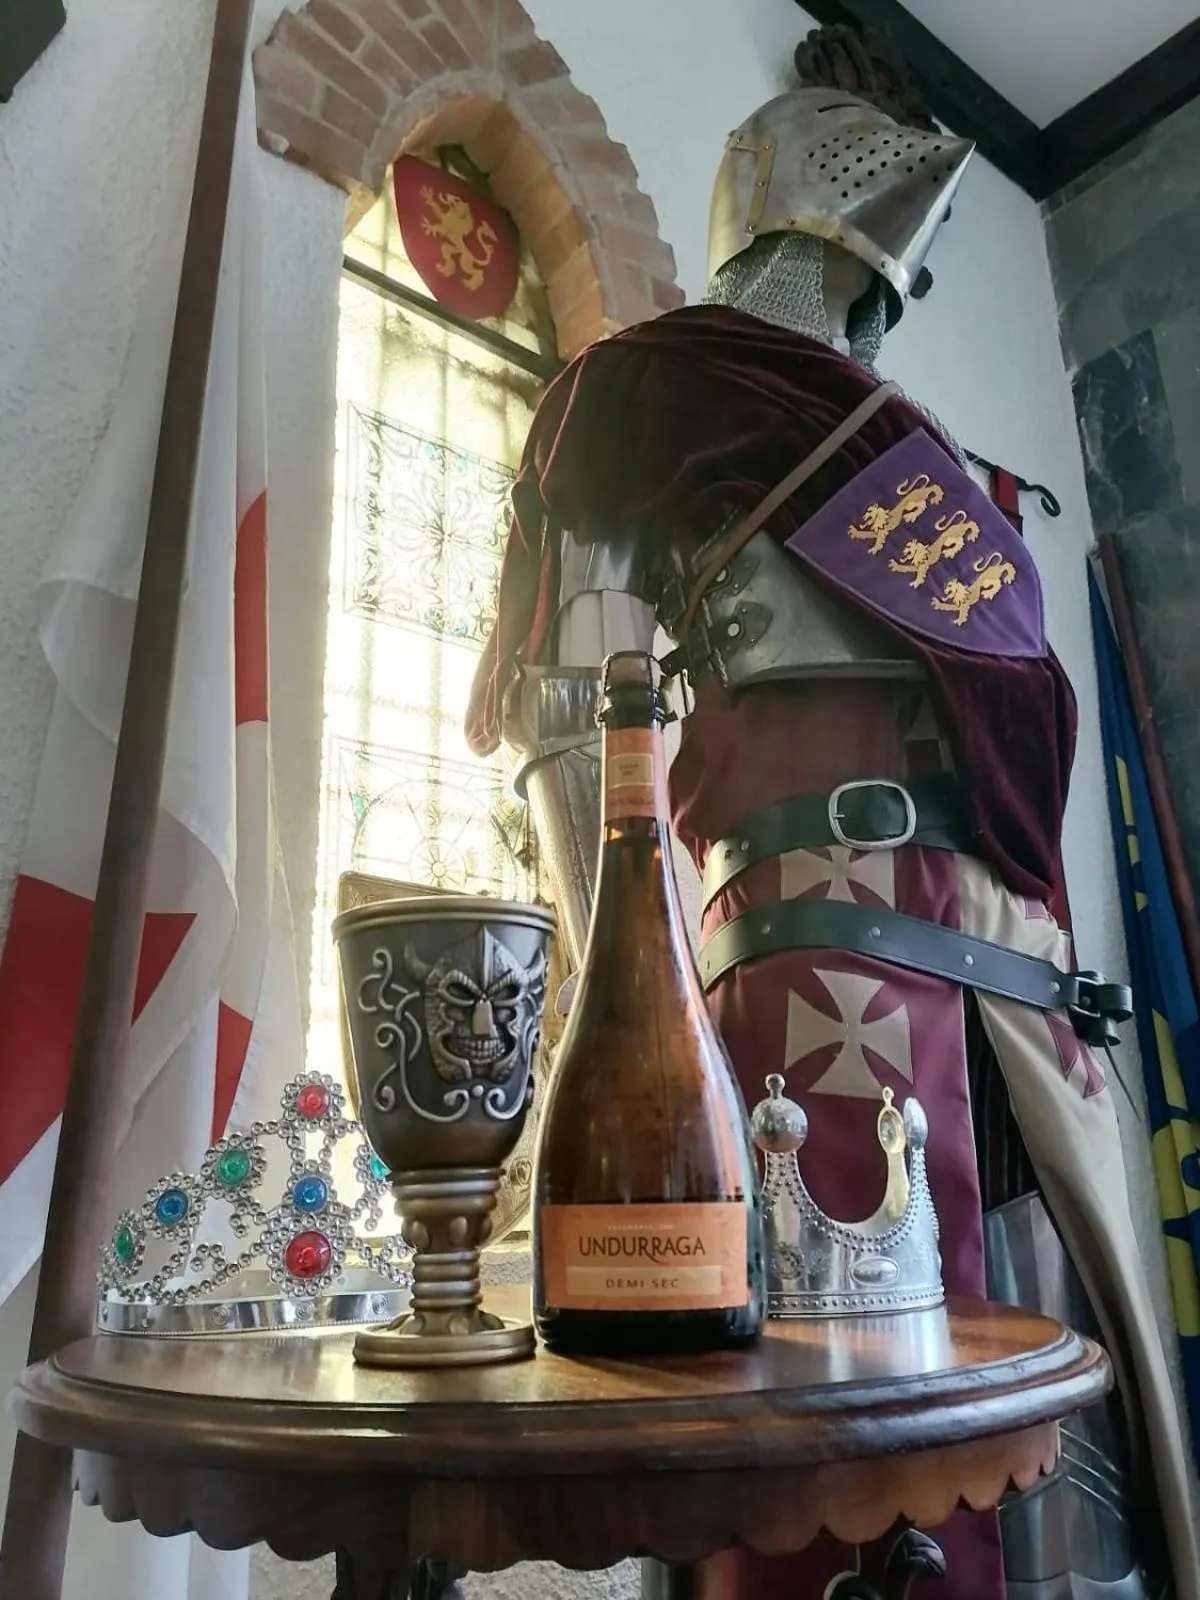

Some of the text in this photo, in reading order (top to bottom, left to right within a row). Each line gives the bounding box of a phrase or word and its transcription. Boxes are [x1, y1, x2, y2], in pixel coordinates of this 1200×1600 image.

[578, 1236, 706, 1265] UNDURRAGA
[606, 1278, 680, 1289] DEMI SEC
